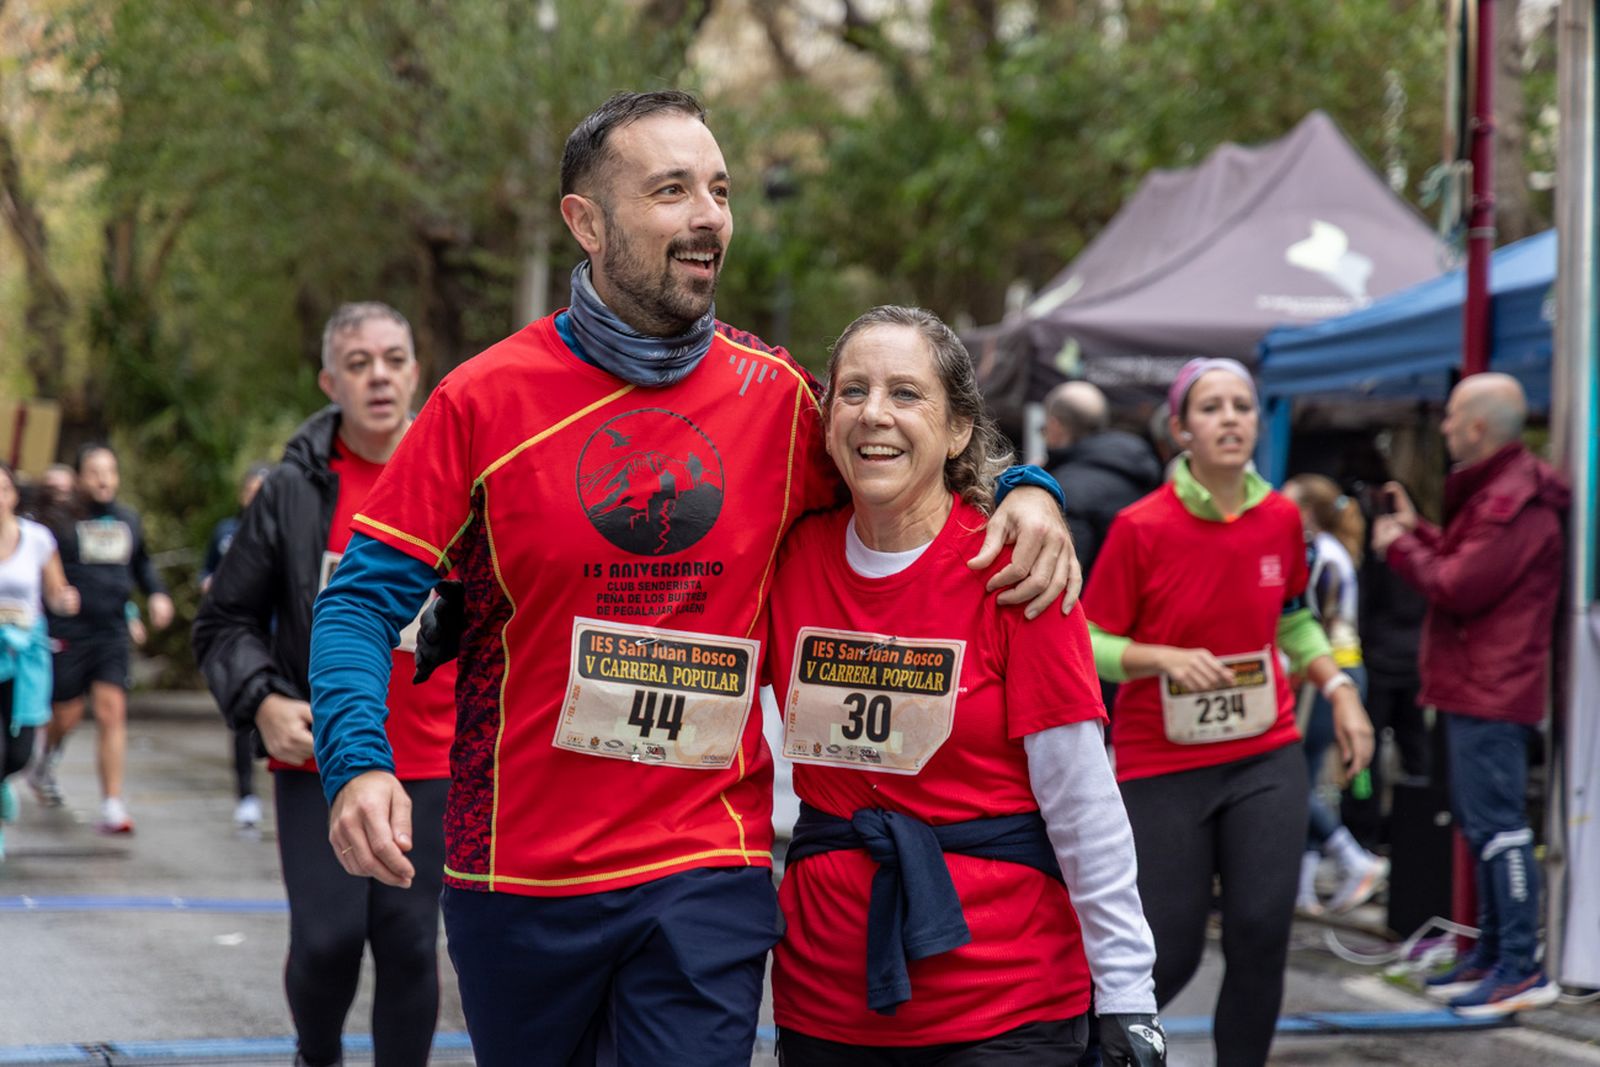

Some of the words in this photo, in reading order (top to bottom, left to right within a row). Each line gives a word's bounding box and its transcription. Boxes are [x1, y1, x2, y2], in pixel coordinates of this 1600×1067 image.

[583, 563, 603, 577] 15
[609, 561, 724, 578] ANIVERSARIO
[596, 592, 625, 603] PEÑA
[628, 594, 641, 603] DE
[644, 594, 665, 603] LOS
[667, 592, 708, 603] BUITRES
[607, 582, 635, 592] CLUB
[638, 580, 702, 591] SENDERISTA
[596, 606, 610, 616] DE
[613, 605, 673, 616] PEGALAJAR
[590, 635, 614, 654] IES
[618, 638, 647, 657] San
[651, 643, 688, 663] Juan
[691, 646, 737, 668] Bosco
[812, 640, 836, 659] IES
[838, 643, 864, 661] San
[865, 646, 899, 664] Juan
[903, 649, 944, 667] Bosco
[585, 655, 596, 674] V
[600, 657, 668, 684] CARRERA
[672, 668, 740, 693] POPULAR
[806, 660, 817, 679] V
[819, 662, 877, 685] CARRERA
[881, 668, 945, 692] POPULAR
[627, 689, 687, 741] 44
[841, 692, 893, 743] 30
[1195, 693, 1247, 724] 234
